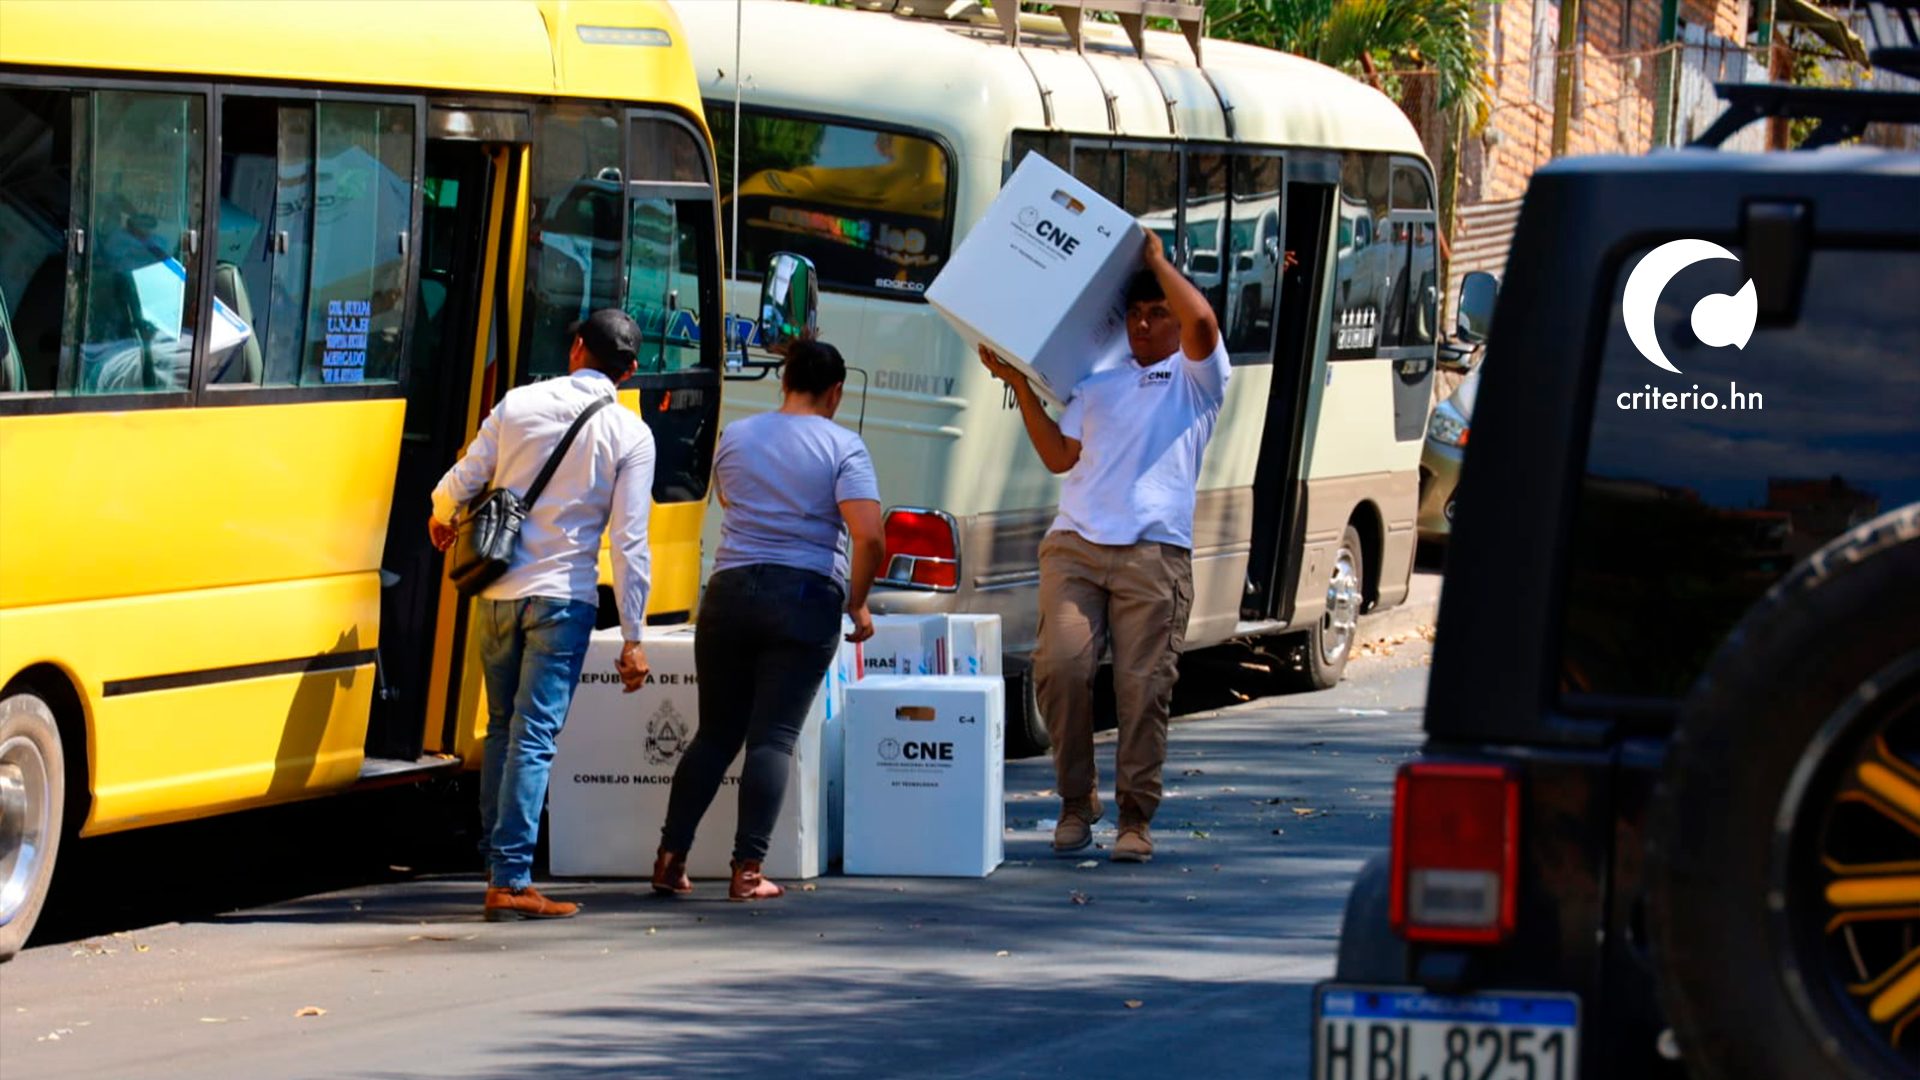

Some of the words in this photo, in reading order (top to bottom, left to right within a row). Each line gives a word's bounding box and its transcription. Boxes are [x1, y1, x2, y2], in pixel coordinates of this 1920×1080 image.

[1036, 220, 1080, 256] CNE
[875, 278, 925, 291] sparco
[874, 369, 955, 396] COUNTY
[660, 674, 679, 685] DE
[958, 715, 976, 724] C-4
[902, 741, 954, 760] CNE
[573, 774, 630, 785] CONSEJO
[1443, 1026, 1565, 1080] 8251
